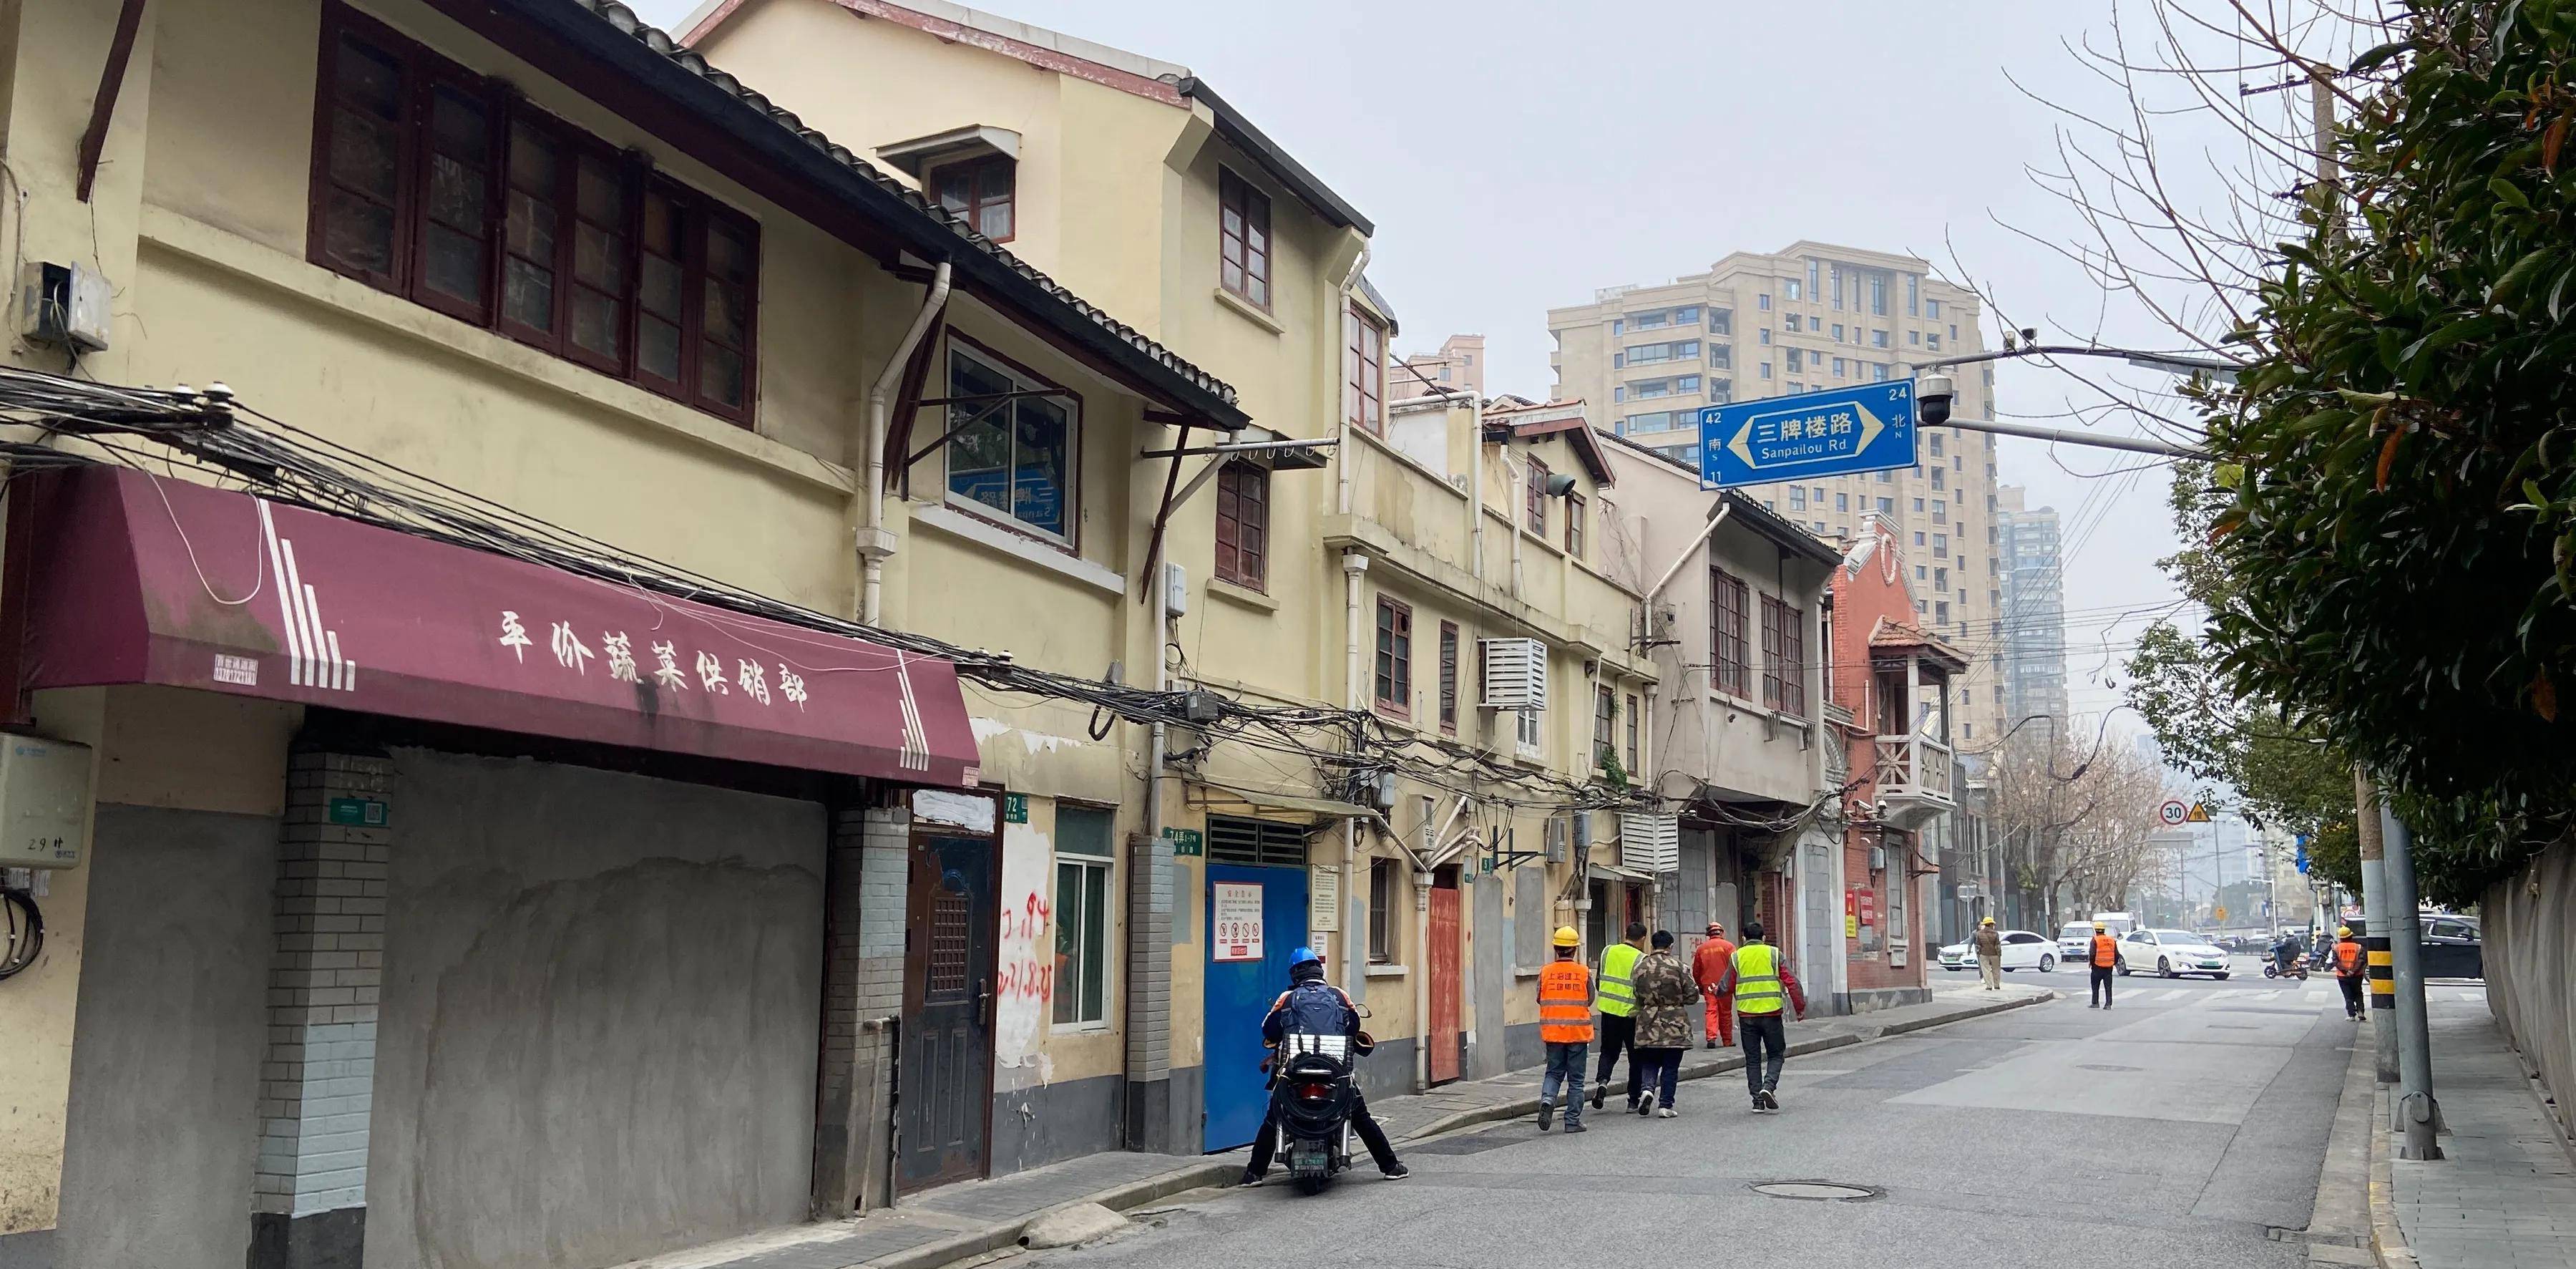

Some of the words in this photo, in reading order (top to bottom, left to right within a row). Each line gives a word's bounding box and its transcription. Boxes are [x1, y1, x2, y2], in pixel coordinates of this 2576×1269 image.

[1888, 386, 1907, 401] 24
[1705, 412, 1722, 424] 42
[1892, 414, 1906, 428] 北
[1757, 412, 1853, 444] 三牌楼路
[1709, 438, 1721, 452] 南
[1762, 443, 1823, 460] Sanpailou
[1828, 439, 1847, 452] Rd
[1711, 471, 1722, 482] 11
[499, 611, 809, 714] 平价蔬菜供销部
[1008, 797, 1017, 812] 72
[2165, 807, 2181, 818] 30
